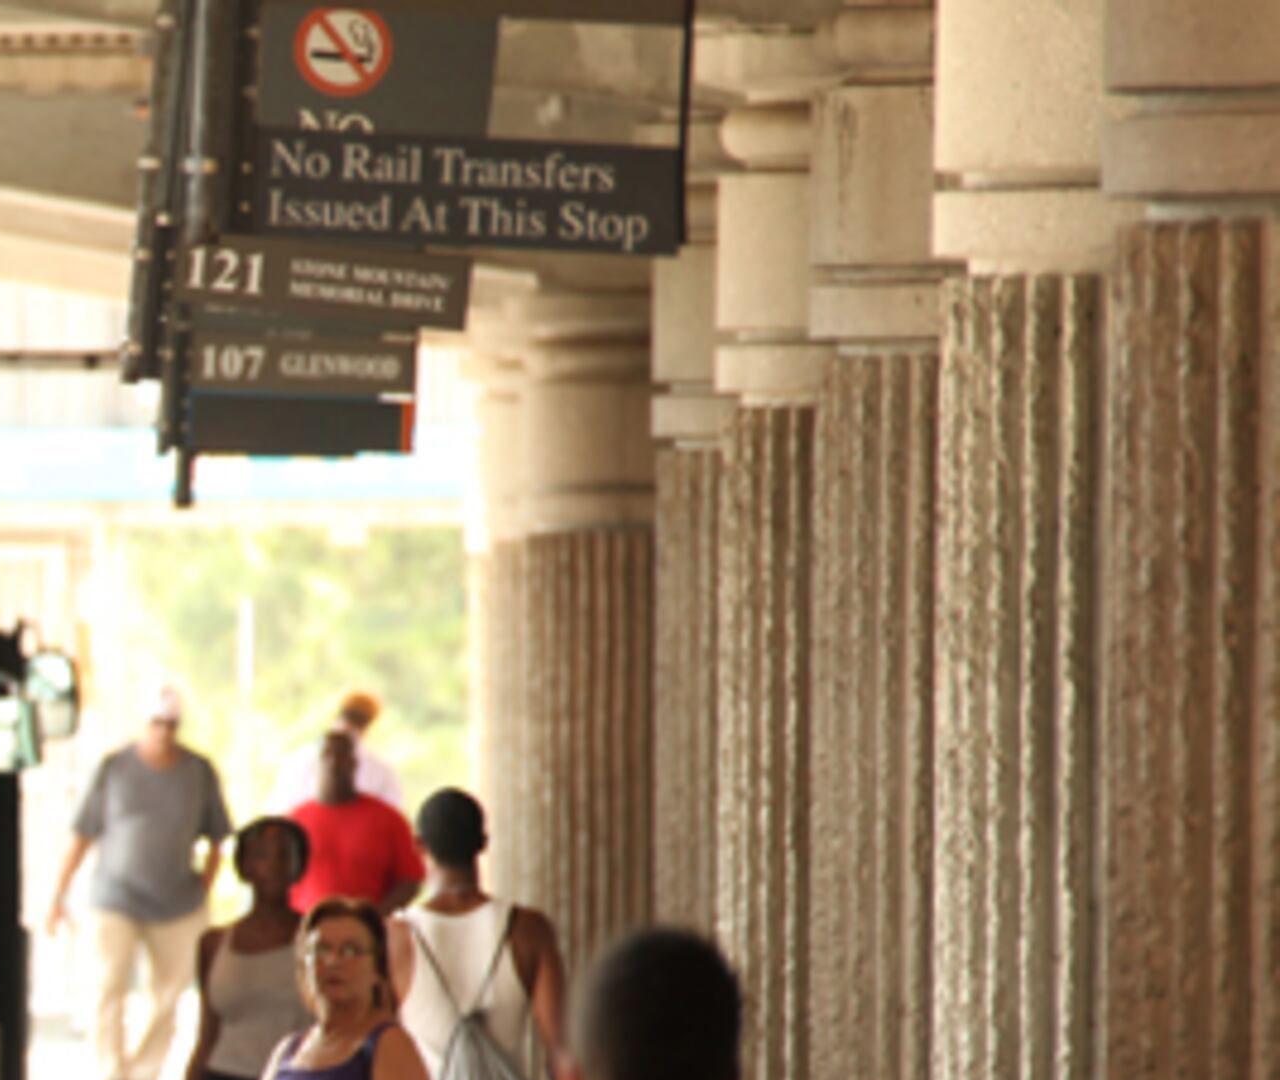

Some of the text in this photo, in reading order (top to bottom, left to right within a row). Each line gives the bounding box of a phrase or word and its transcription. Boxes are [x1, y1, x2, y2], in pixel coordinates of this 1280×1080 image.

[270, 139, 616, 193] No Rail Transfers
[267, 189, 650, 252] Issued At This Stop
[186, 246, 264, 295] 121
[203, 344, 402, 381] 107 GLENWOOD
